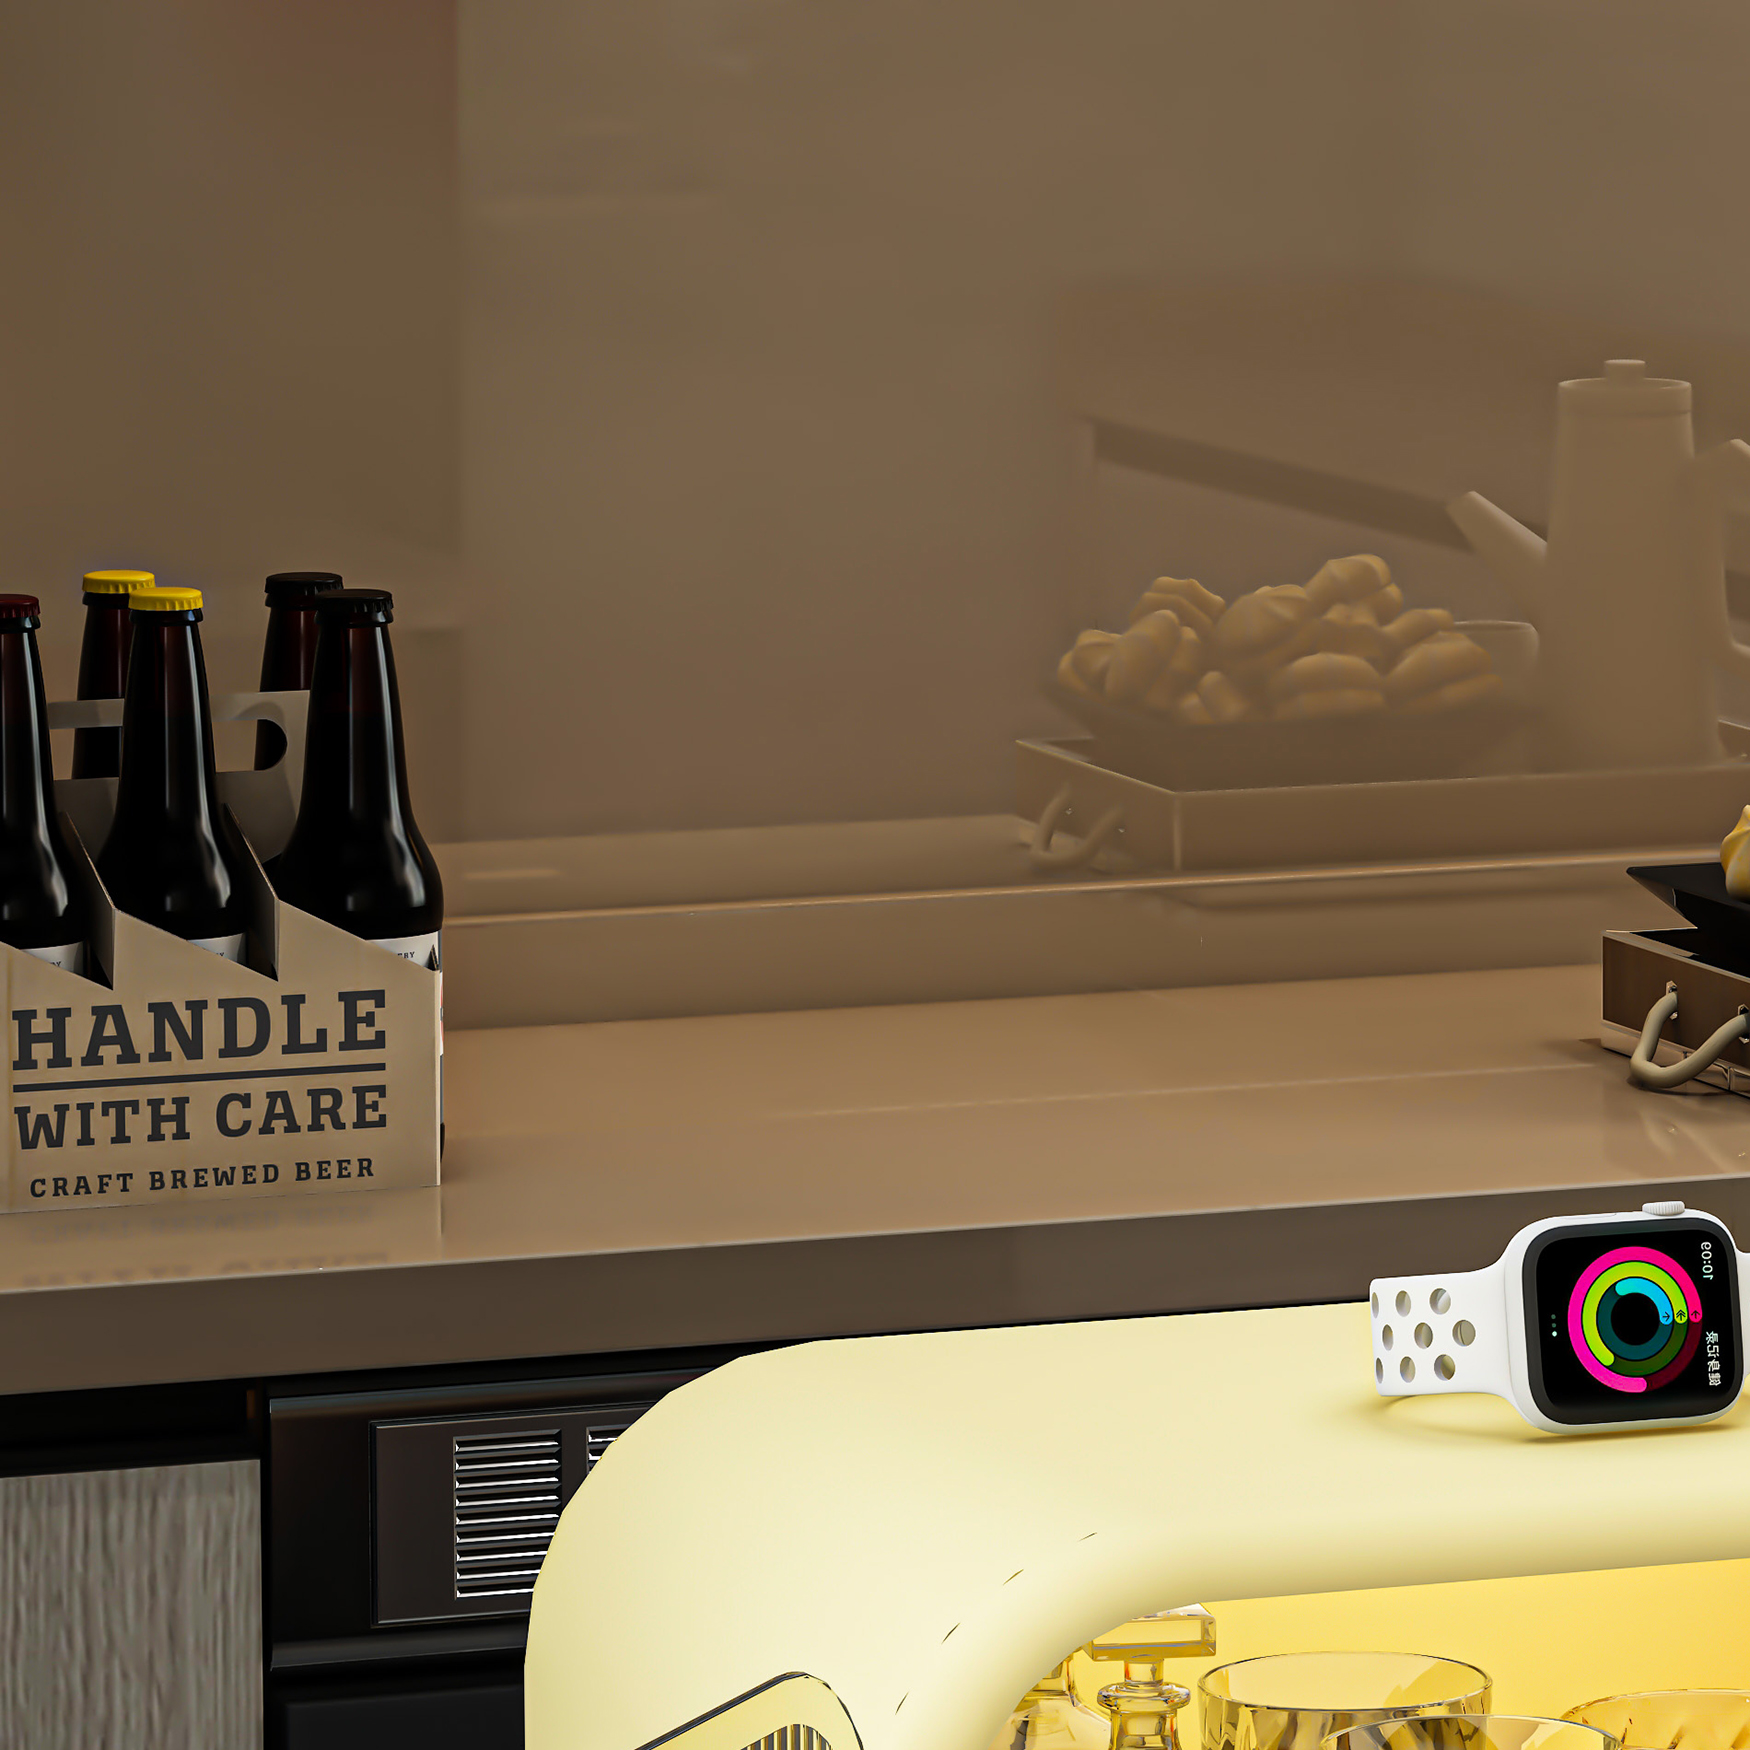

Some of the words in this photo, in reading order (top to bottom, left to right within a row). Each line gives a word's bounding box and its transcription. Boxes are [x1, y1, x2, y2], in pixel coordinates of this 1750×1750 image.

[12, 989, 387, 1071] HANDLE
[14, 1096, 190, 1150] WITH
[215, 1084, 387, 1138] CARE
[30, 1173, 134, 1198] CRAFT
[149, 1163, 280, 1191] BREWED
[295, 1158, 374, 1182] BEER
